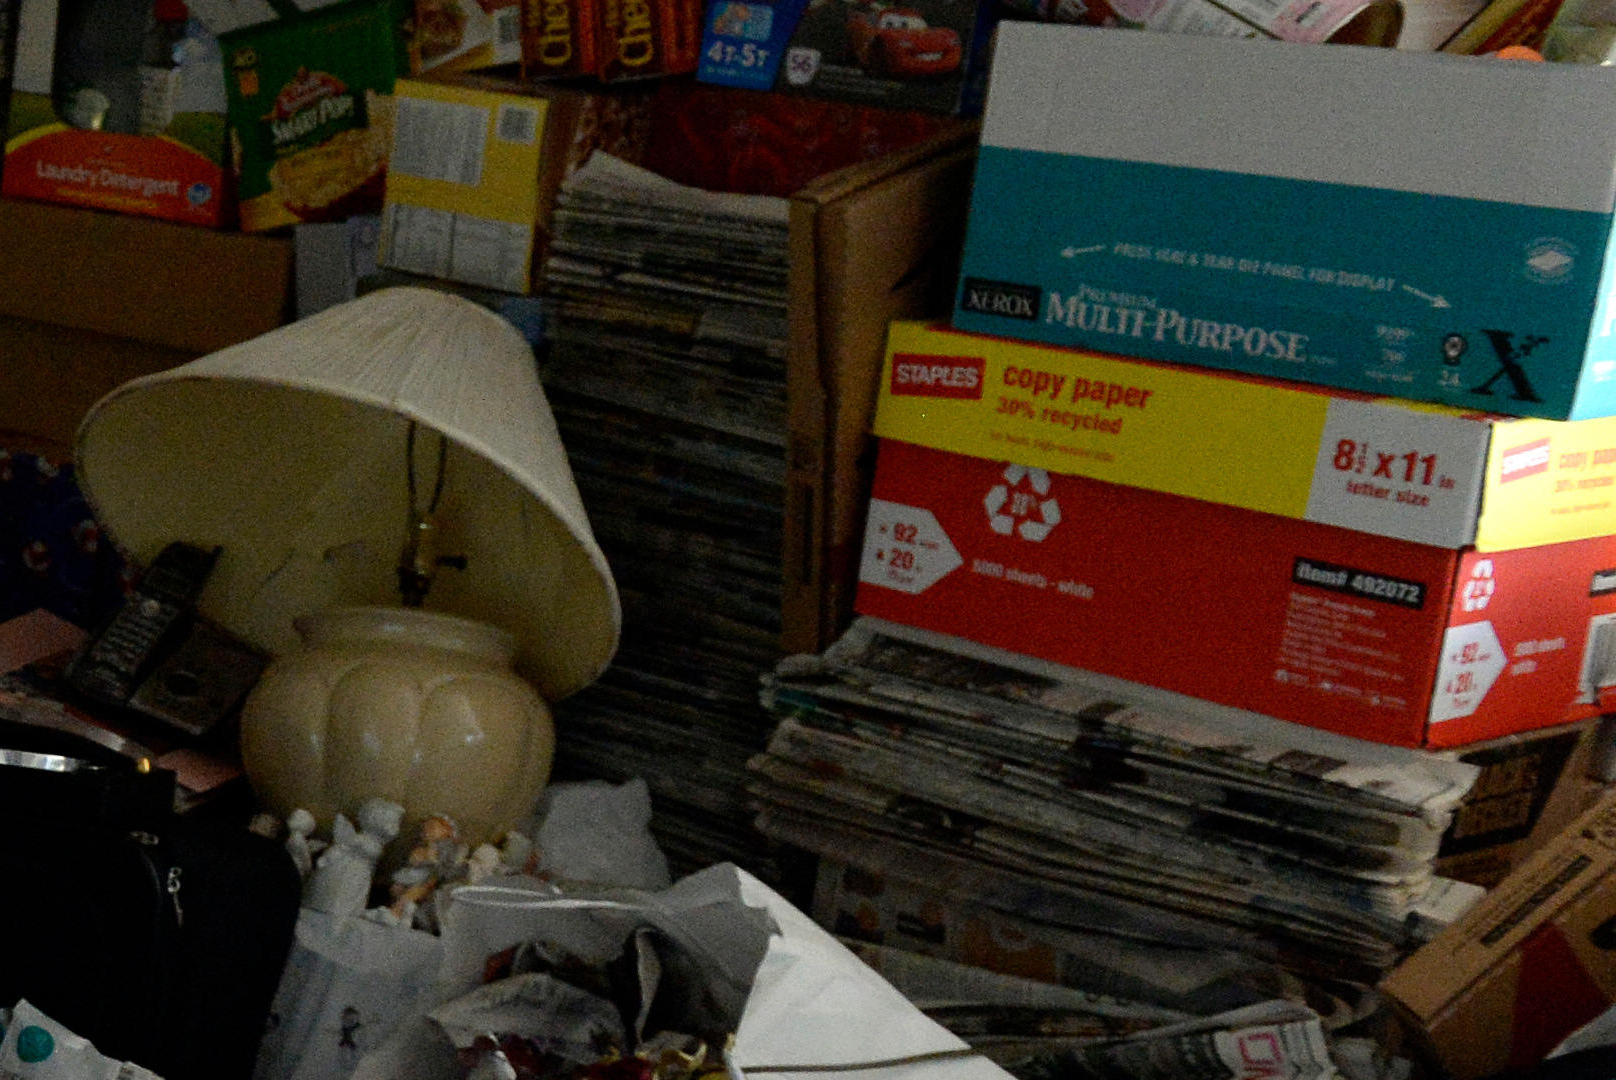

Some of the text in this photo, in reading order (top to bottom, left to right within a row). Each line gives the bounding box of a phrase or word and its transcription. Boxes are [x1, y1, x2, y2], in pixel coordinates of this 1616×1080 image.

[35, 159, 97, 188] Laundry
[99, 167, 180, 198] Detergent
[967, 290, 1034, 317] XEROX
[1046, 290, 1310, 362] MULTI-PURPOSE
[896, 363, 980, 388] STAPLES
[1003, 365, 1155, 409] copy paper
[996, 396, 1124, 434] 30% recycled
[1396, 489, 1431, 508] size
[889, 548, 915, 570] 20
